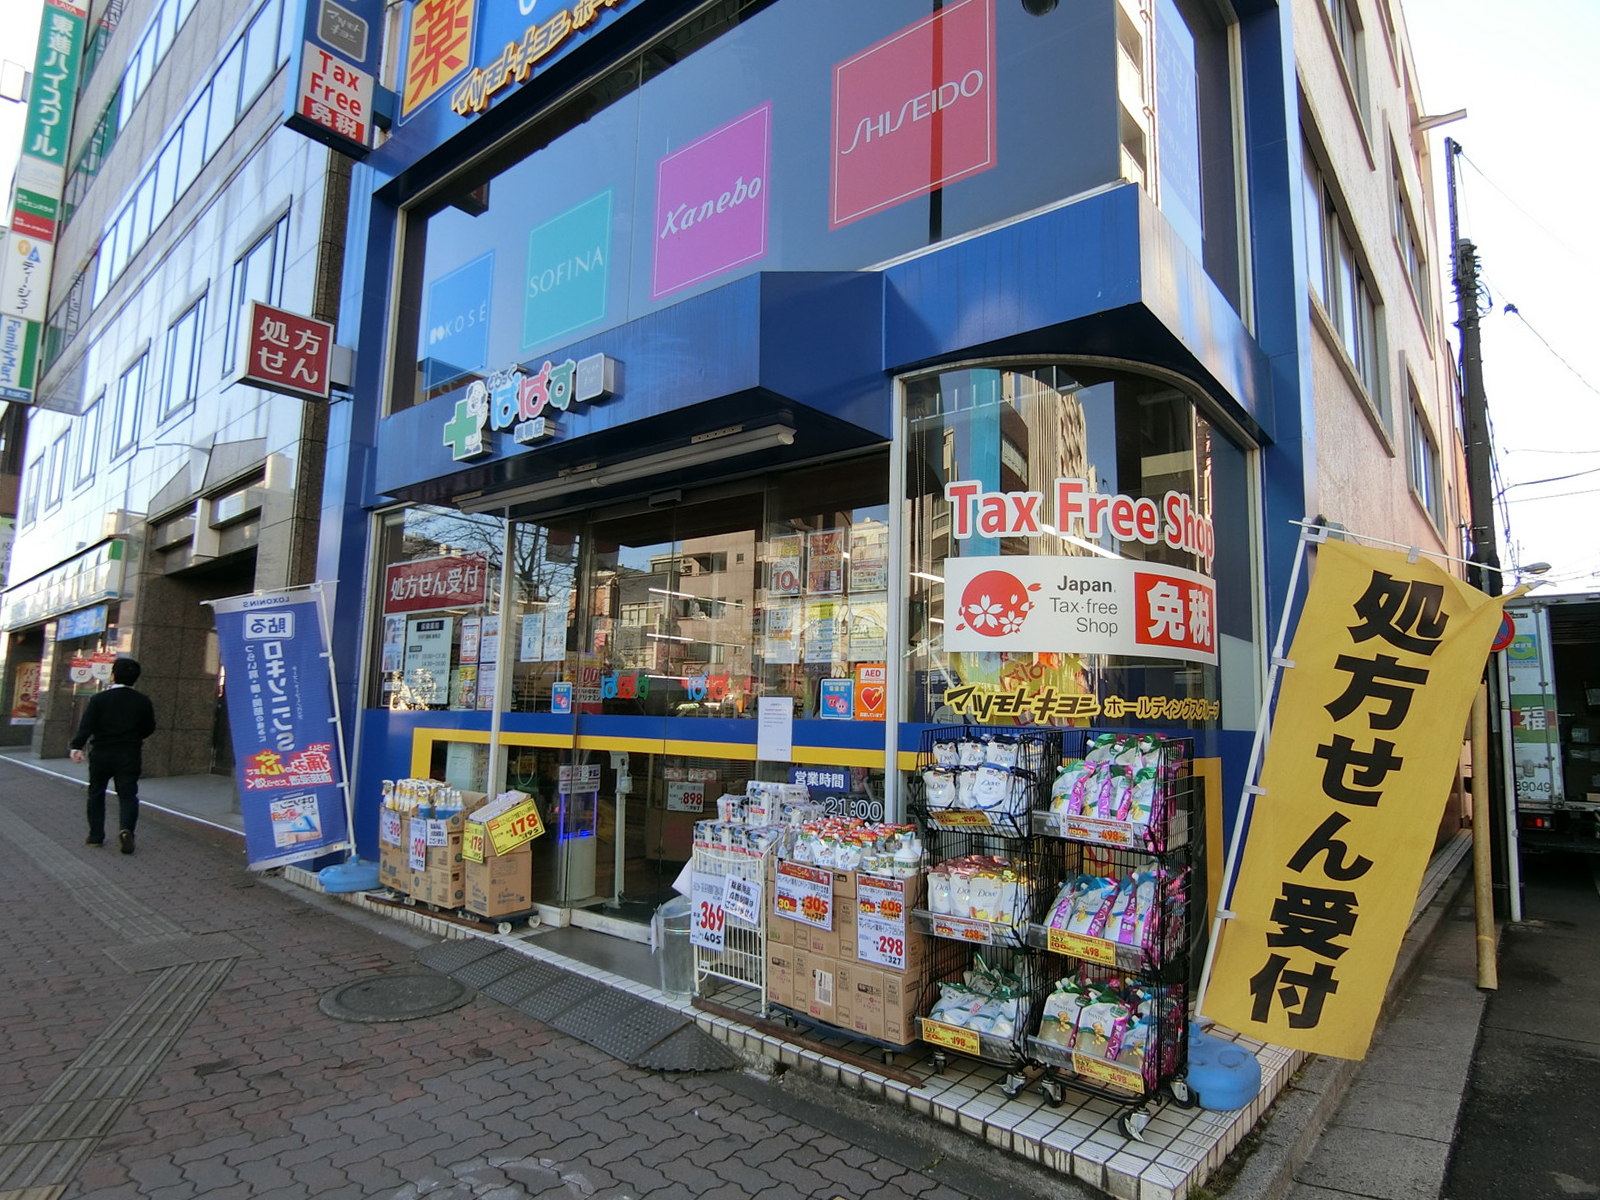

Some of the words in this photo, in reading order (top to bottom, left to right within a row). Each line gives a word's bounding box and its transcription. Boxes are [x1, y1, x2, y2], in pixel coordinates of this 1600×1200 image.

[408, 0, 468, 106] 薬
[452, 10, 573, 115] マツモトキヨシ
[319, 50, 360, 92] Tax
[32, 13, 76, 157] 東進ハイスクール
[310, 72, 362, 117] Free
[311, 102, 358, 140] 免税
[841, 70, 984, 154] SHISEIDO
[660, 176, 762, 239] Kanebo
[529, 246, 604, 298] SOFINA
[445, 303, 487, 337] KOSÉ
[260, 316, 323, 355] 処方
[0, 319, 21, 383] FamilyMart
[258, 348, 320, 384] せん
[491, 359, 576, 431] ぱぱす
[946, 481, 1042, 538] Tax
[1056, 479, 1158, 542] Free
[1165, 492, 1215, 572] Shop
[390, 565, 481, 602] 処方せん受付
[1147, 581, 1211, 647] 免税
[1076, 617, 1118, 637] Shop
[864, 669, 882, 678] AED
[944, 684, 1101, 725] マツモトキヨシ
[1104, 694, 1220, 721] ホールディングスグループ
[1520, 706, 1547, 731] 福
[795, 770, 845, 788] 営業時間
[981, 779, 1000, 787] Dove
[683, 792, 703, 806] 898
[1250, 570, 1449, 1030] 処方せん受付
[511, 813, 538, 836] 178
[524, 827, 539, 838] 195
[1101, 829, 1119, 841] 498
[470, 835, 483, 852] 178
[778, 898, 790, 910] 30
[978, 888, 998, 898] Dove
[700, 900, 724, 932] 369
[805, 895, 829, 915] 305
[860, 903, 871, 913] 60
[880, 898, 903, 913] 408
[704, 931, 722, 945] 405
[879, 935, 904, 957] 298
[964, 928, 980, 941] 258
[1050, 941, 1066, 950] 100
[888, 955, 901, 966] 327
[1085, 946, 1100, 958] 498
[951, 1035, 967, 1048] 198
[1111, 1072, 1127, 1085] 498
